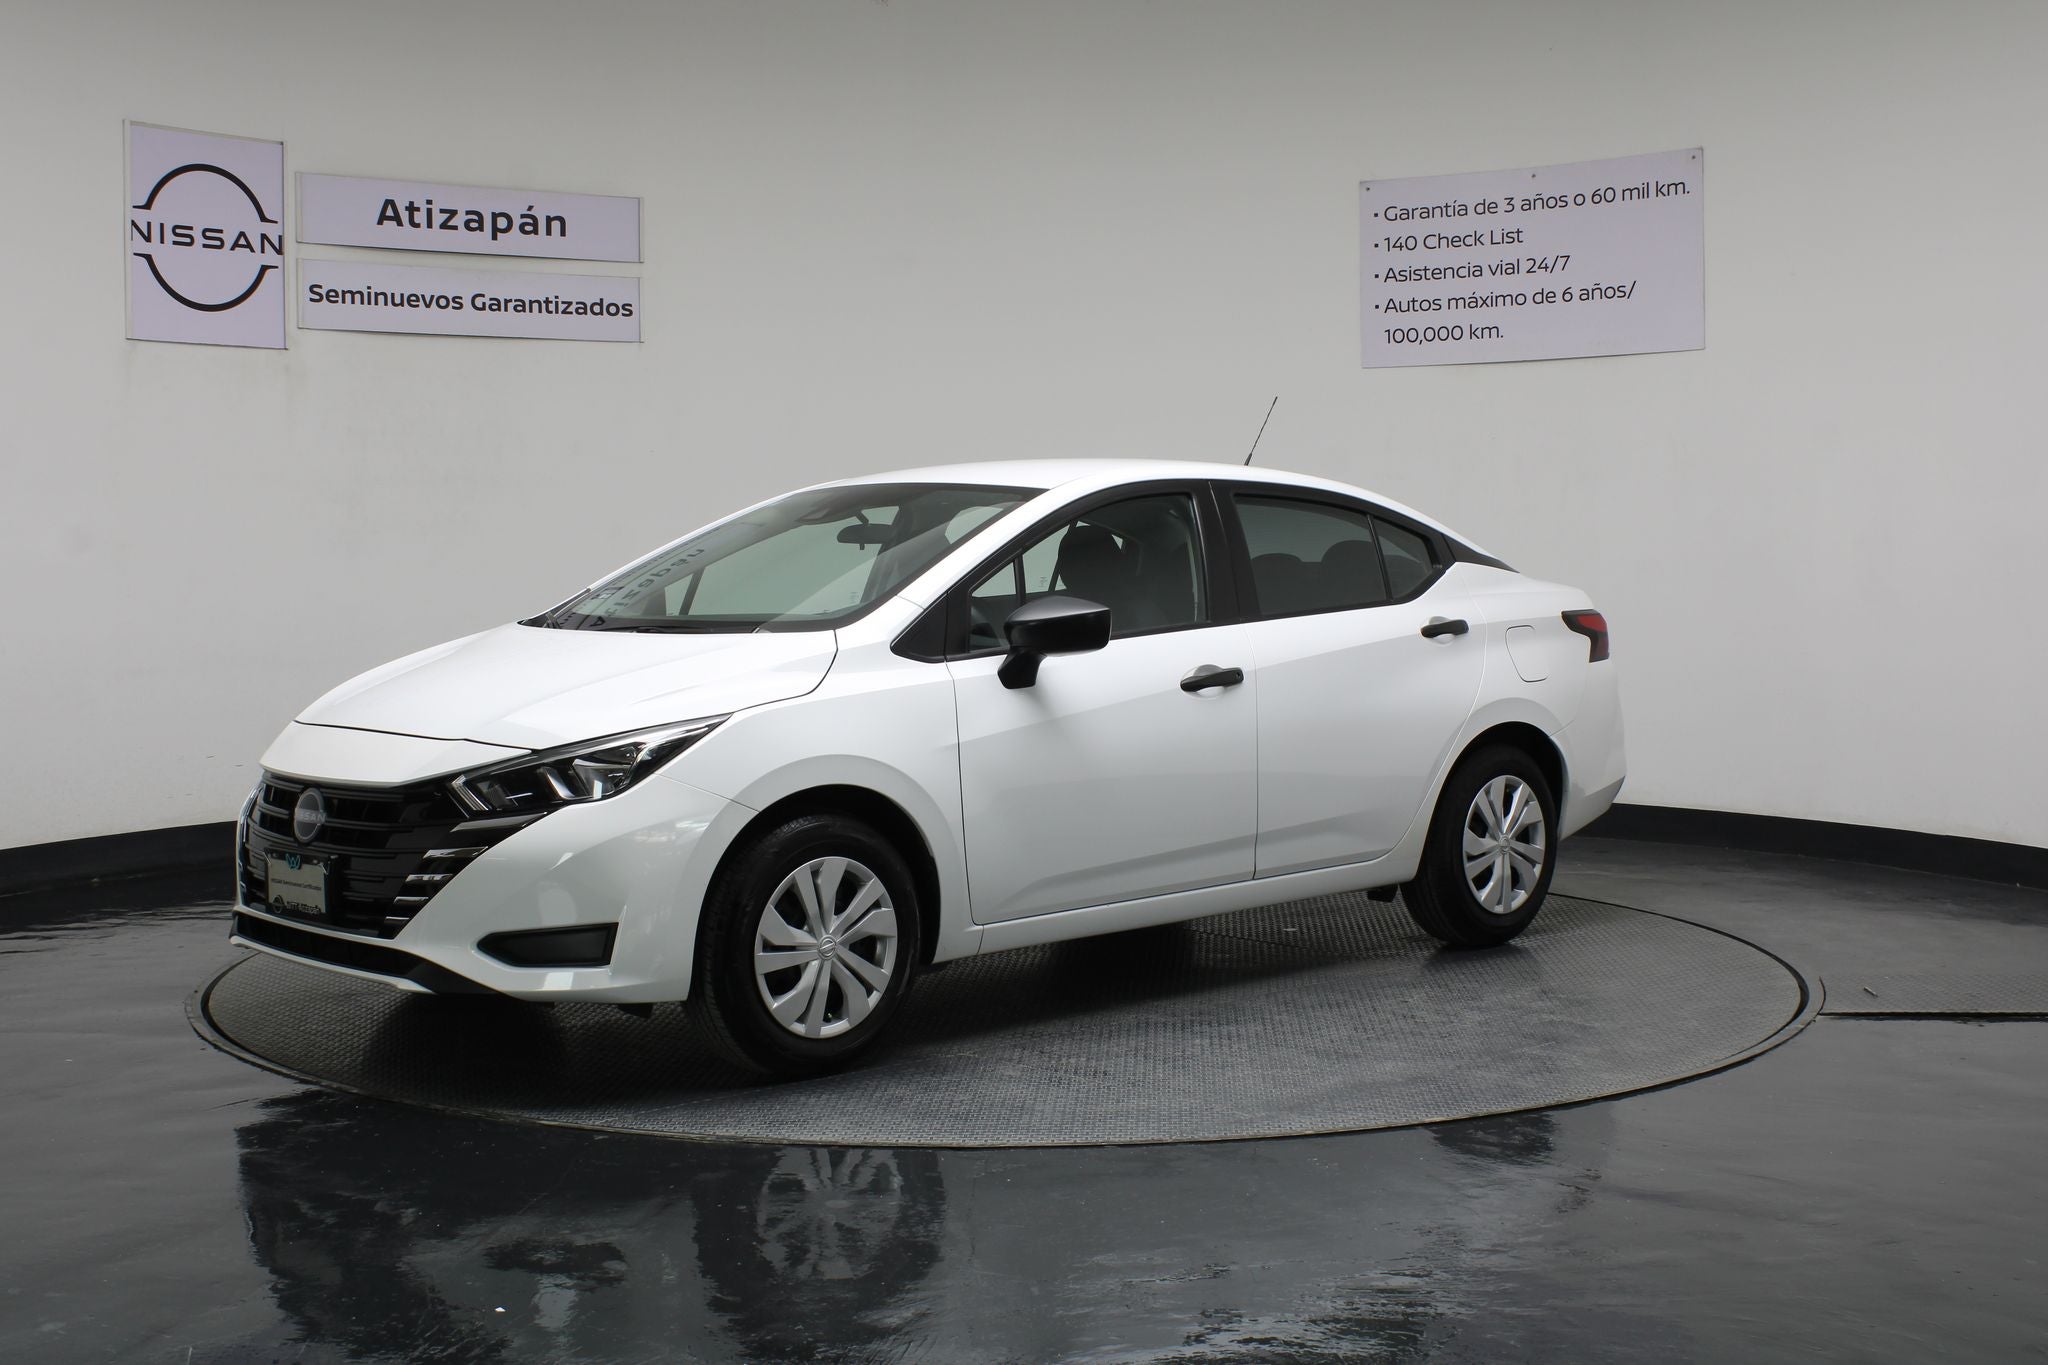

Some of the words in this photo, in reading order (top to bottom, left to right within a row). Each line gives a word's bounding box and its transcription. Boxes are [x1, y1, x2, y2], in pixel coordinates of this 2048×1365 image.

[1384, 200, 1469, 222] Garantía
[1474, 198, 1499, 216] de
[1504, 196, 1515, 214] 3
[1521, 192, 1569, 212] años
[1574, 193, 1586, 207] o
[1591, 186, 1617, 205] 60
[1622, 182, 1650, 202] mil
[1656, 180, 1691, 198] km.
[131, 219, 285, 256] NISSAN
[377, 198, 567, 244] Atizapán
[1384, 235, 1418, 253] 140
[1423, 230, 1485, 250] Check
[1491, 228, 1524, 246] List
[1384, 261, 1483, 283] Asistencia
[1487, 257, 1520, 277] vial
[1526, 254, 1571, 275] 24/7
[309, 284, 464, 311] Seminuevos
[471, 293, 634, 318] Garantizados
[1384, 297, 1442, 314] Autos
[1448, 291, 1527, 311] máximo
[1533, 287, 1557, 305] de
[1562, 286, 1574, 303] 6
[1579, 280, 1637, 302] años/
[1384, 326, 1464, 346] 100,000
[1470, 323, 1504, 341] km.
